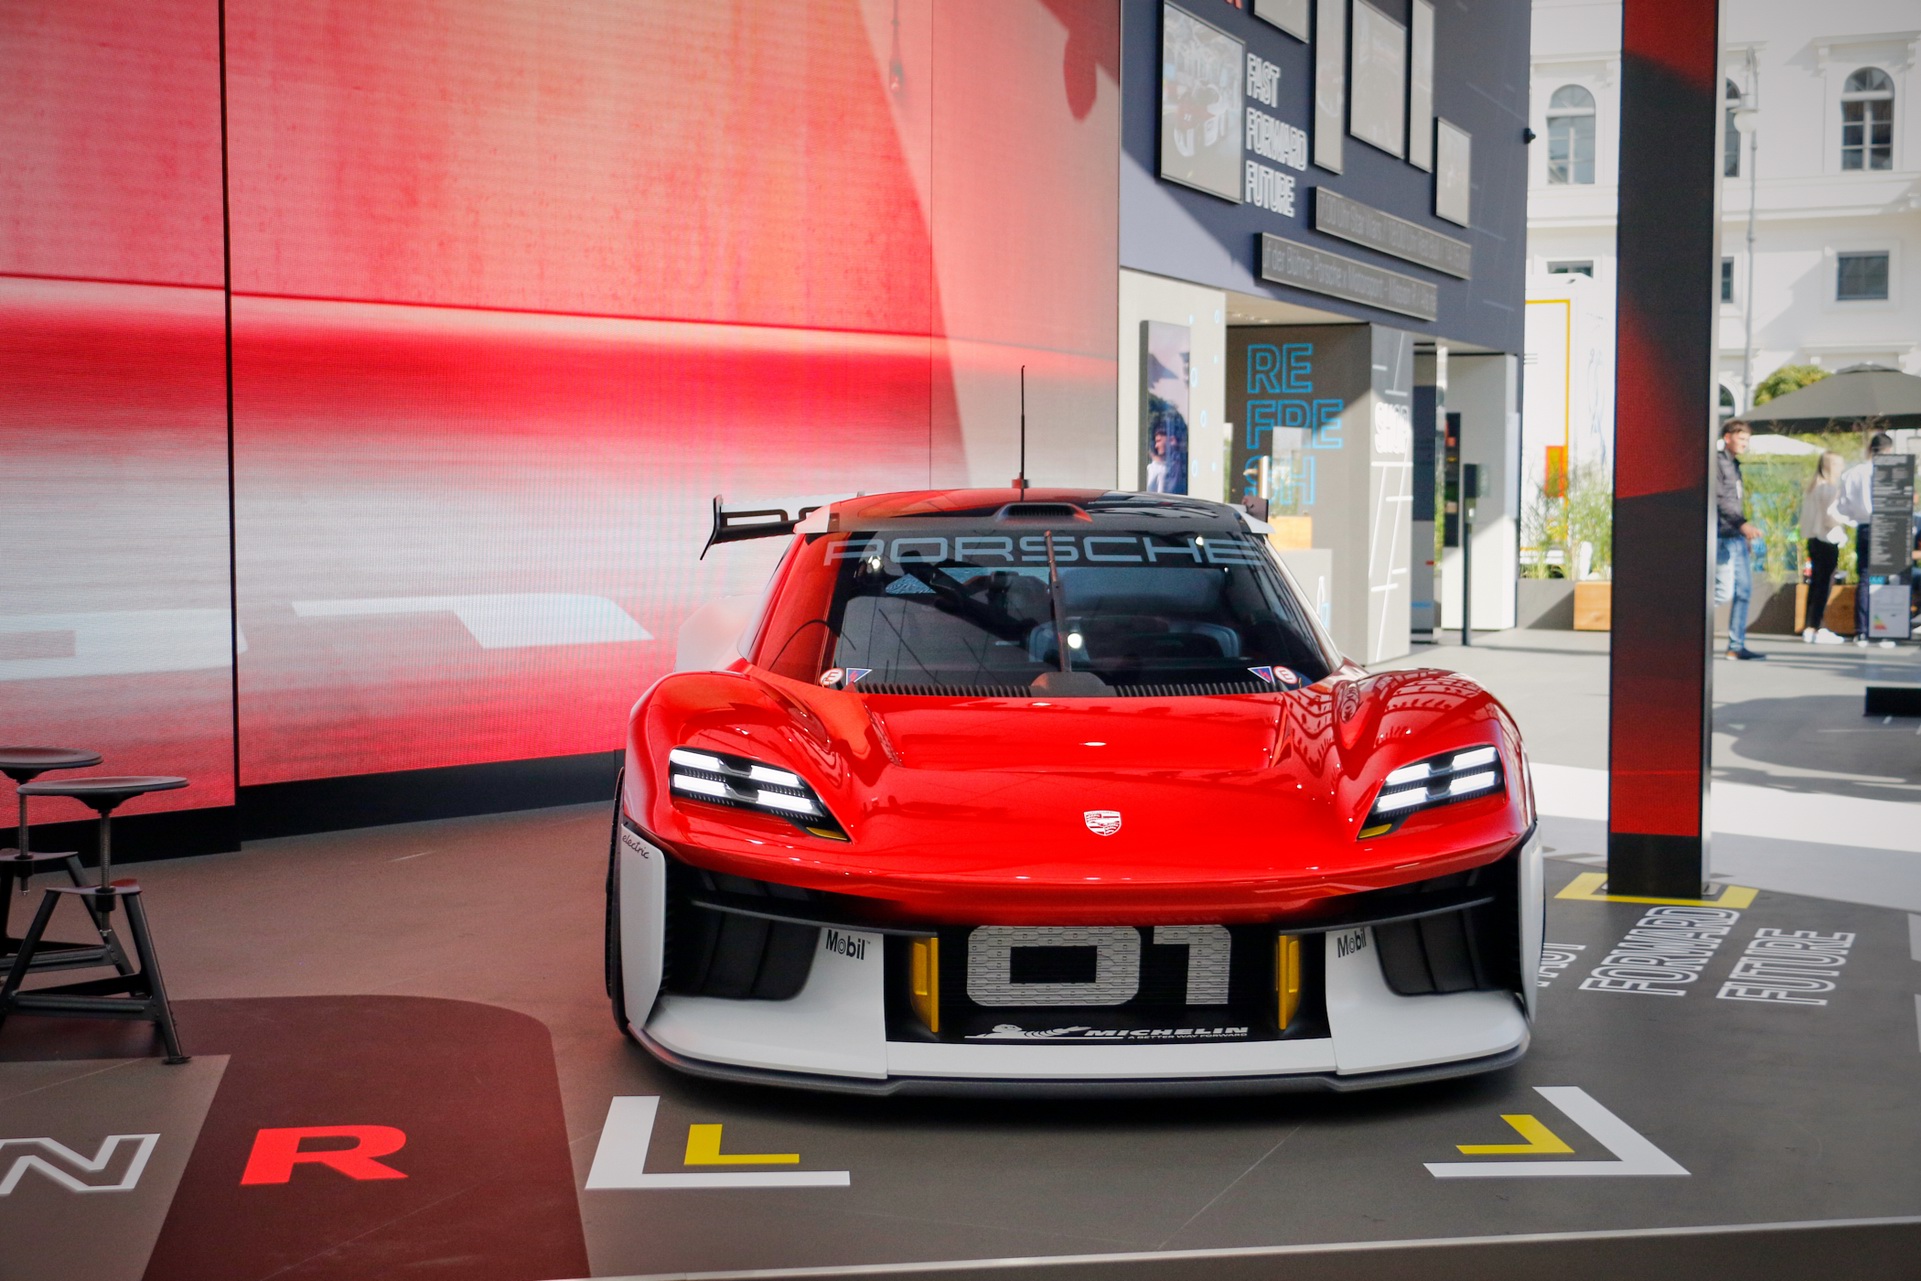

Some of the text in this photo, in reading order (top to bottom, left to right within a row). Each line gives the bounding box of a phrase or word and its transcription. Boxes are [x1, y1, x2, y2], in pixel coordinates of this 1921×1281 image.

[1246, 52, 1281, 108] FAST
[1245, 107, 1309, 172] FORWARD
[1245, 160, 1296, 217] FUTURE
[1247, 343, 1313, 393] RE
[823, 536, 1264, 567] PORSCHE
[622, 834, 651, 860] electric
[825, 929, 866, 961] Mobil
[967, 925, 1232, 1006] 01
[1337, 927, 1367, 959] Mobil
[1578, 906, 1741, 997] FORWARD
[1716, 927, 1857, 1006] FUTURE
[1084, 1026, 1249, 1036] MICHELIN
